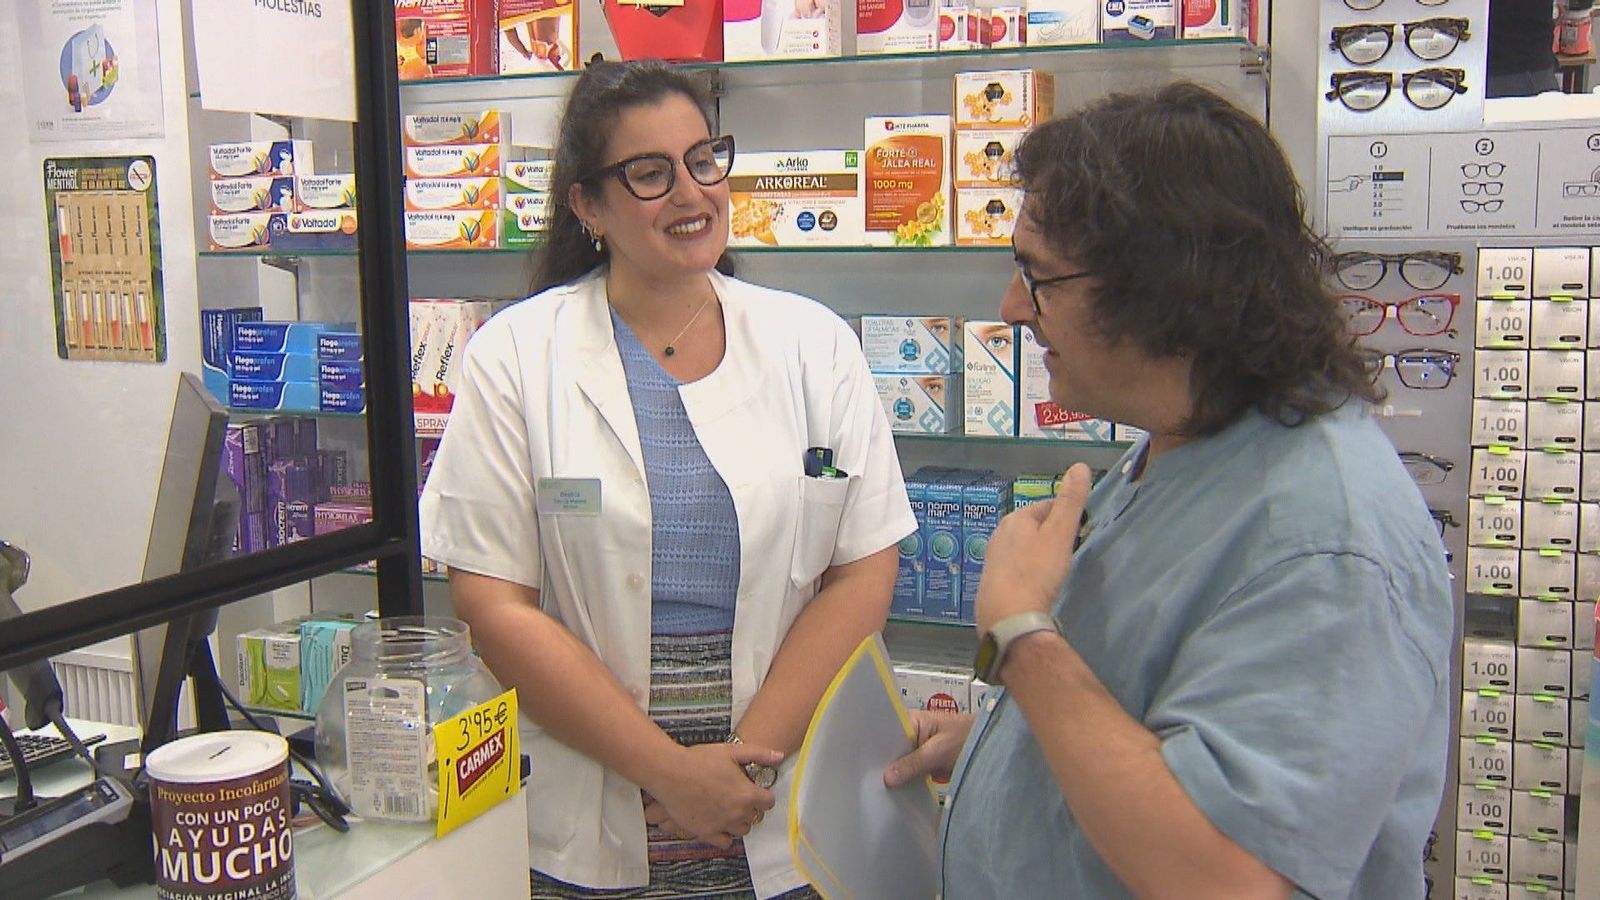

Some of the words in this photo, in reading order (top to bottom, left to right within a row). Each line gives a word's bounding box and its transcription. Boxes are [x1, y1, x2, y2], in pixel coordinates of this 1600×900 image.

[415, 148, 441, 156] Voltadol
[785, 157, 809, 168] Arko
[881, 158, 910, 168] JALEA
[912, 158, 936, 168] REAL
[47, 166, 78, 179] Flower
[47, 178, 78, 190] MENTHOL
[755, 177, 827, 190] ARKOREAL
[873, 180, 896, 189] 1000
[898, 181, 913, 190] mg
[302, 218, 337, 228] Voltadol
[1486, 266, 1524, 280] 1.00
[1485, 316, 1523, 332] 1.00
[435, 343, 455, 381] Reflex
[1482, 367, 1520, 382] 1.00
[416, 417, 449, 429] SPRAY
[1480, 416, 1518, 432] 1.00
[1480, 466, 1518, 482] 1.00
[927, 501, 960, 512] normo
[927, 510, 945, 518] mar
[963, 503, 997, 513] normo
[963, 511, 982, 519] mar
[1476, 516, 1514, 531] 1.00
[1474, 565, 1511, 580] 1.00
[1471, 661, 1508, 676] 1.00
[1470, 709, 1507, 724] 1.00
[460, 732, 504, 780] CARMEX
[1468, 756, 1505, 772] 1.00
[158, 786, 215, 805] Proyecto
[176, 811, 209, 825] CON
[214, 808, 239, 825] UN
[244, 796, 280, 820] POCO
[1466, 802, 1502, 818] 1.00
[169, 808, 286, 848] AYUDAS
[161, 828, 292, 883] MUCHO
[1465, 849, 1501, 865] 1.00
[265, 881, 277, 891] LA
